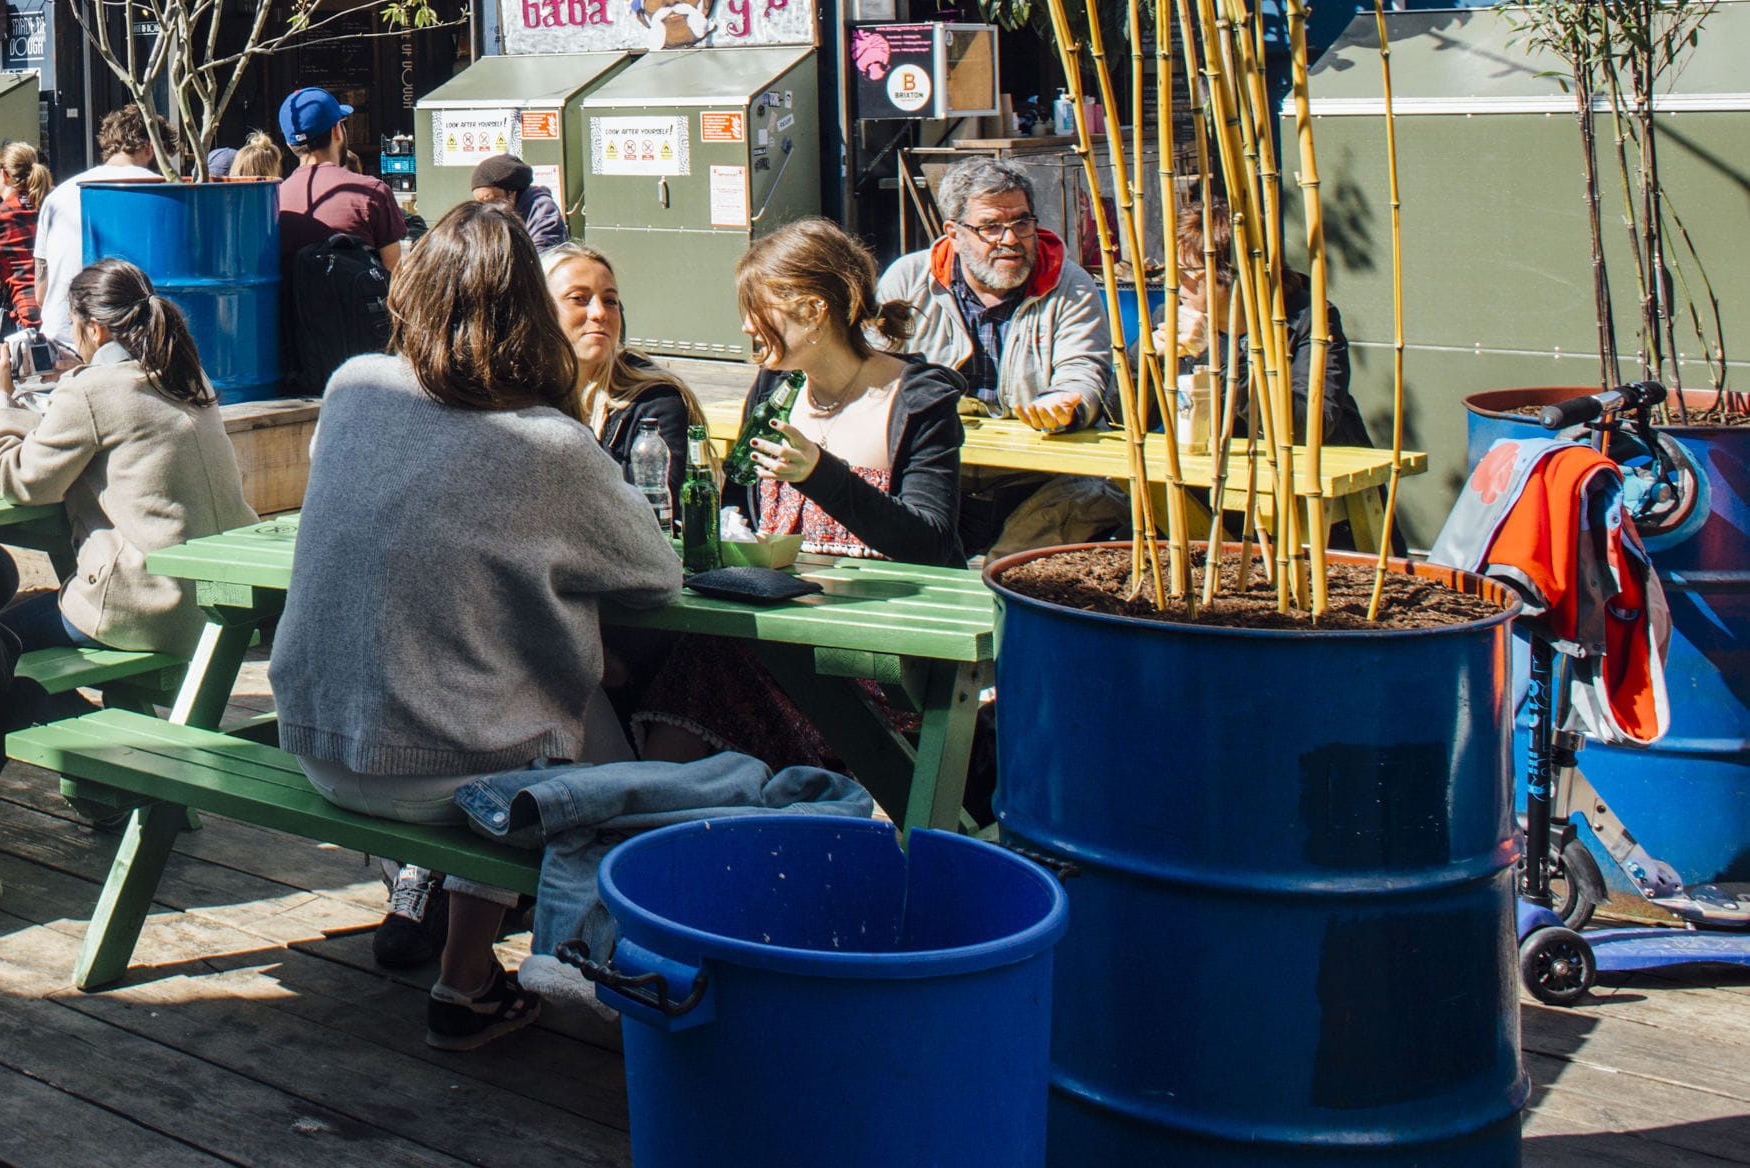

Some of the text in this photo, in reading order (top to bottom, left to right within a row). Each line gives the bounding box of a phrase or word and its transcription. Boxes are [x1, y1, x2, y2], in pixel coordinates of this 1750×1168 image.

[10, 36, 44, 57] DOUGH
[902, 73, 916, 91] B
[641, 124, 673, 135] YOURSELF!
